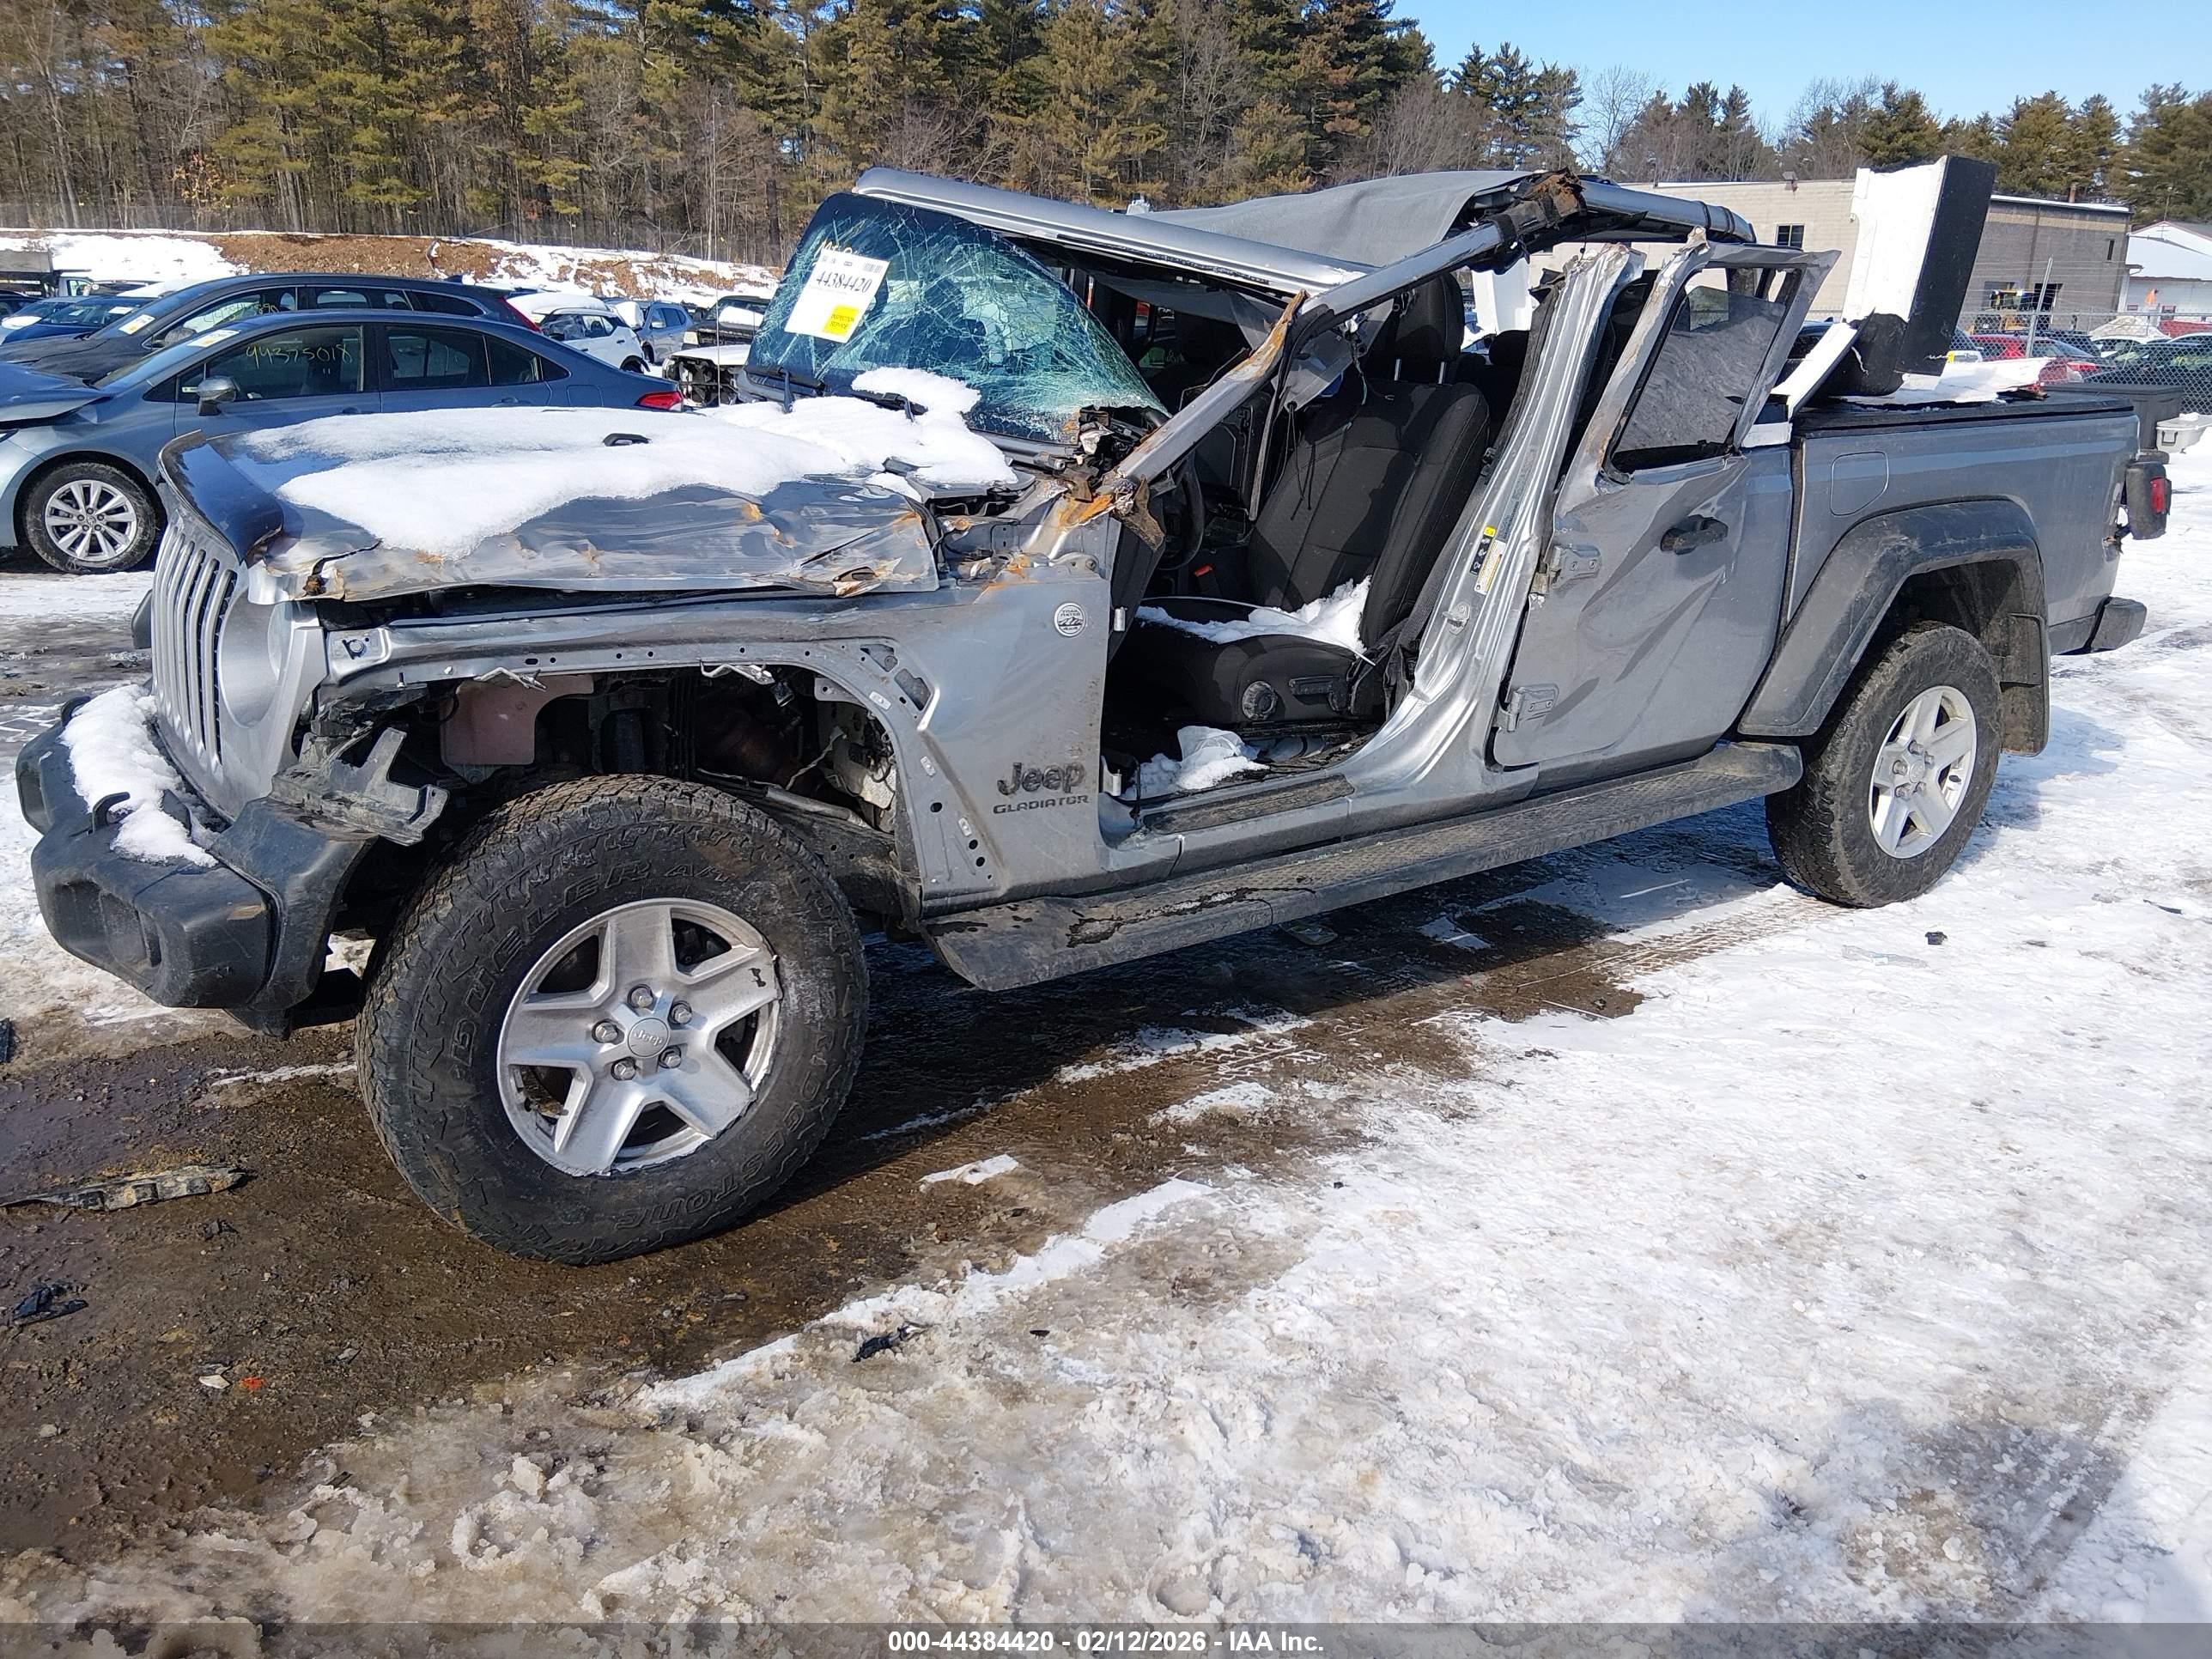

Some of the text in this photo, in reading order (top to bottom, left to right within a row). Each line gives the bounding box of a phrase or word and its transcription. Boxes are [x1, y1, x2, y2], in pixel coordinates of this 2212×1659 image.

[817, 271, 872, 293] 44384420
[246, 343, 353, 369] 44375018
[997, 763, 1086, 795] Jeep
[993, 794, 1090, 814] GLADIATOR
[453, 861, 652, 1066] DUELER
[634, 1030, 663, 1047] Jeep
